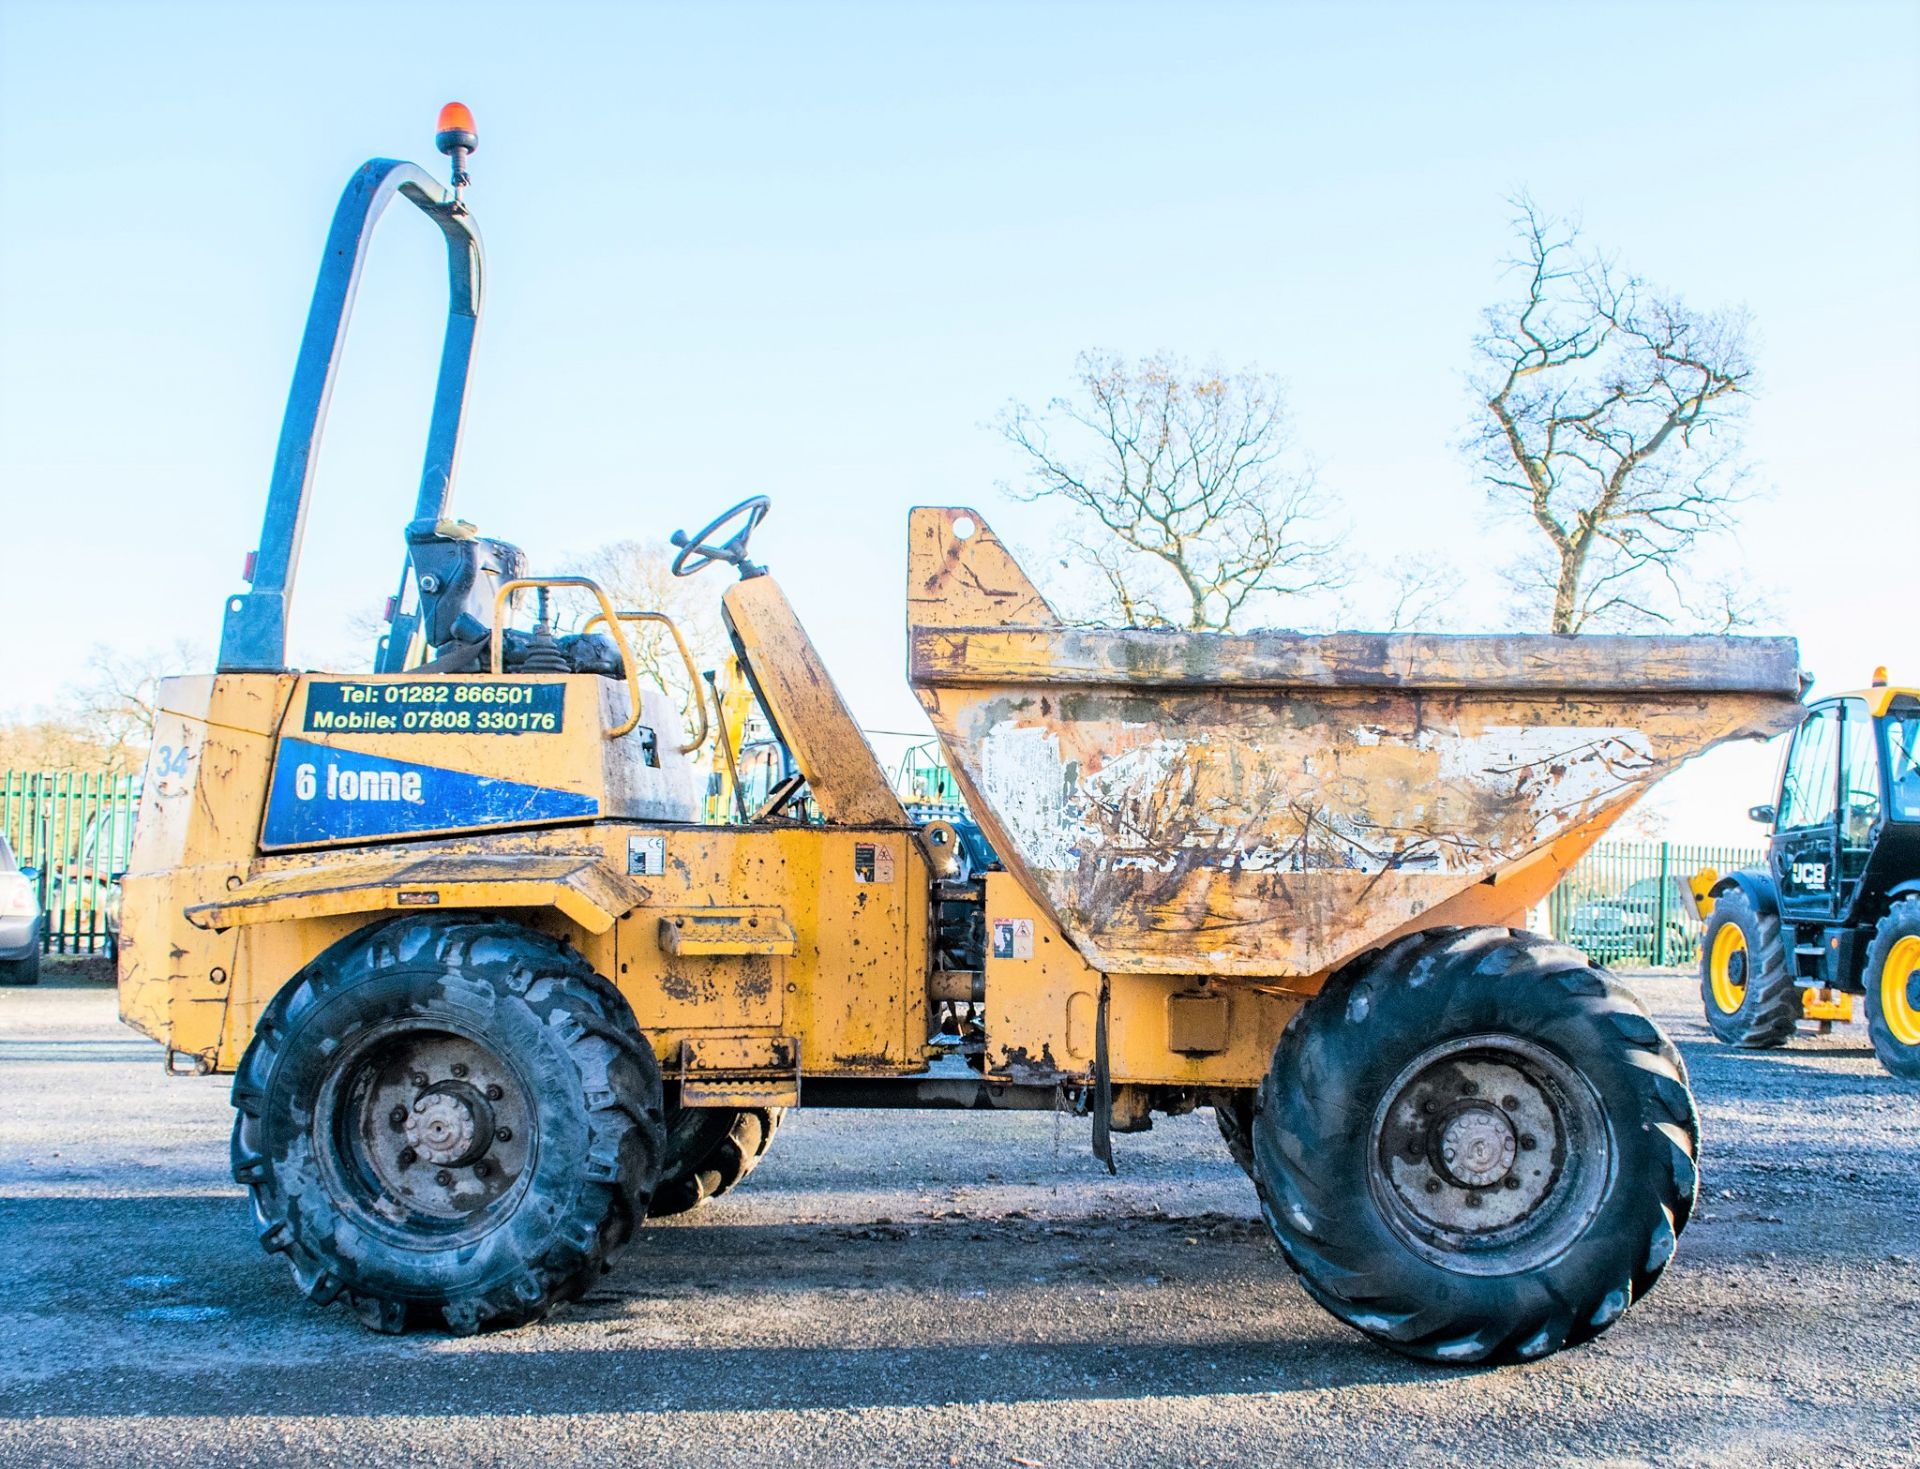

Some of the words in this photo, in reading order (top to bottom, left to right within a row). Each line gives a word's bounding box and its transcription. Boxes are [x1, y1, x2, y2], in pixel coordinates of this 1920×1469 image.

[340, 686, 379, 703] Tel:
[384, 686, 449, 703] 01282
[453, 686, 533, 704] 866501
[313, 711, 397, 729] Mobile:
[403, 711, 471, 729] 07808
[476, 711, 556, 730] 330176
[156, 745, 189, 779] 34
[295, 763, 317, 801] 6
[327, 763, 422, 802] tonne
[1792, 862, 1826, 884] JCB
